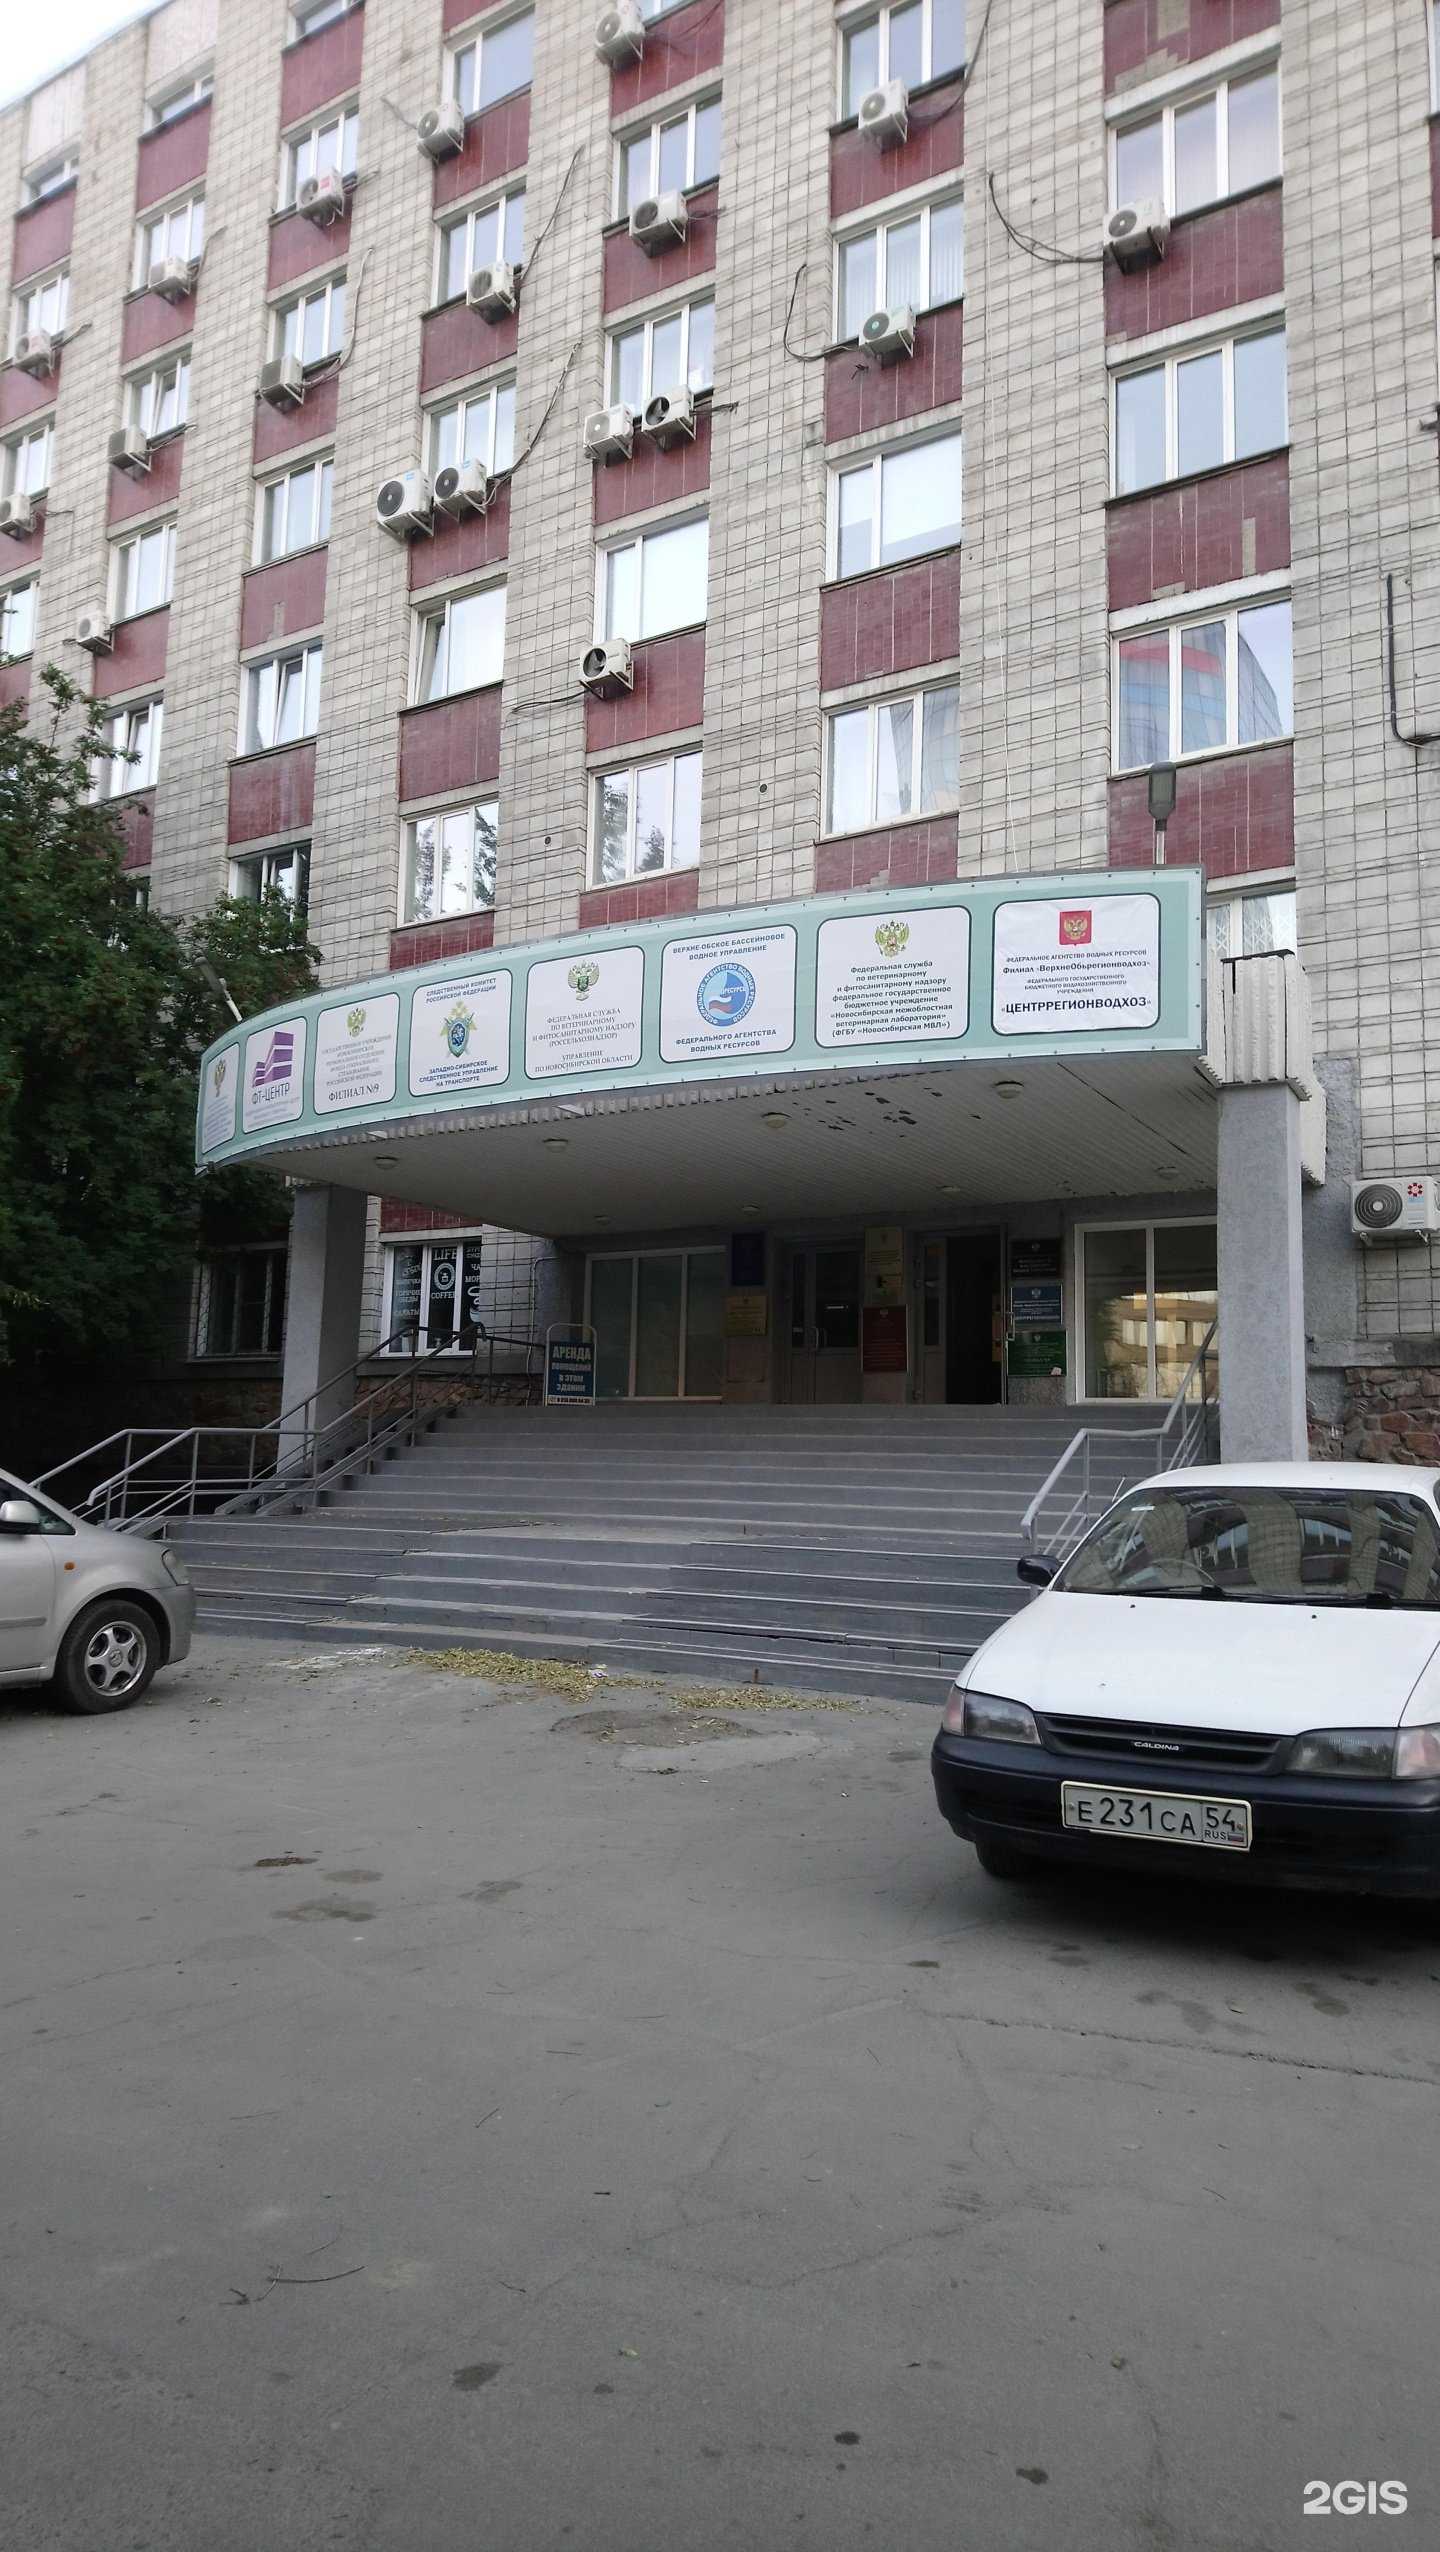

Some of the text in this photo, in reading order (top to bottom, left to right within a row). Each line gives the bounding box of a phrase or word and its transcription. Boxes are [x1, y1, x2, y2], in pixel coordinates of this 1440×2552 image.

[689, 945, 767, 961] ВОДНОЕ УПРАВЛЕНИЕ
[850, 960, 933, 974] Федеральная служба
[1002, 966, 1035, 974] Филиал
[867, 970, 927, 981] ветеринарному
[843, 981, 913, 994] фитосанитарному
[914, 977, 947, 987] надзору
[832, 986, 952, 1002] федеральное государственное
[844, 996, 938, 1010] бюджетное учреждение
[835, 1017, 889, 1028] ветеринарная
[676, 1029, 777, 1045] ФЕДЕРАЛЬНОГО АГЕНТСТВА
[832, 1028, 856, 1038] (ФГБУ
[690, 1040, 760, 1053] ВОДНЫХ РЕСУРСОВ
[252, 1082, 290, 1104] ФТ-ЦЕНТР
[329, 1086, 364, 1101] ФИЛИАЛ
[552, 1345, 592, 1361] АРЕНДА
[1133, 1741, 1180, 1751] CALDINA
[1206, 1807, 1236, 1831] 54
[1204, 1829, 1228, 1841] RUS
